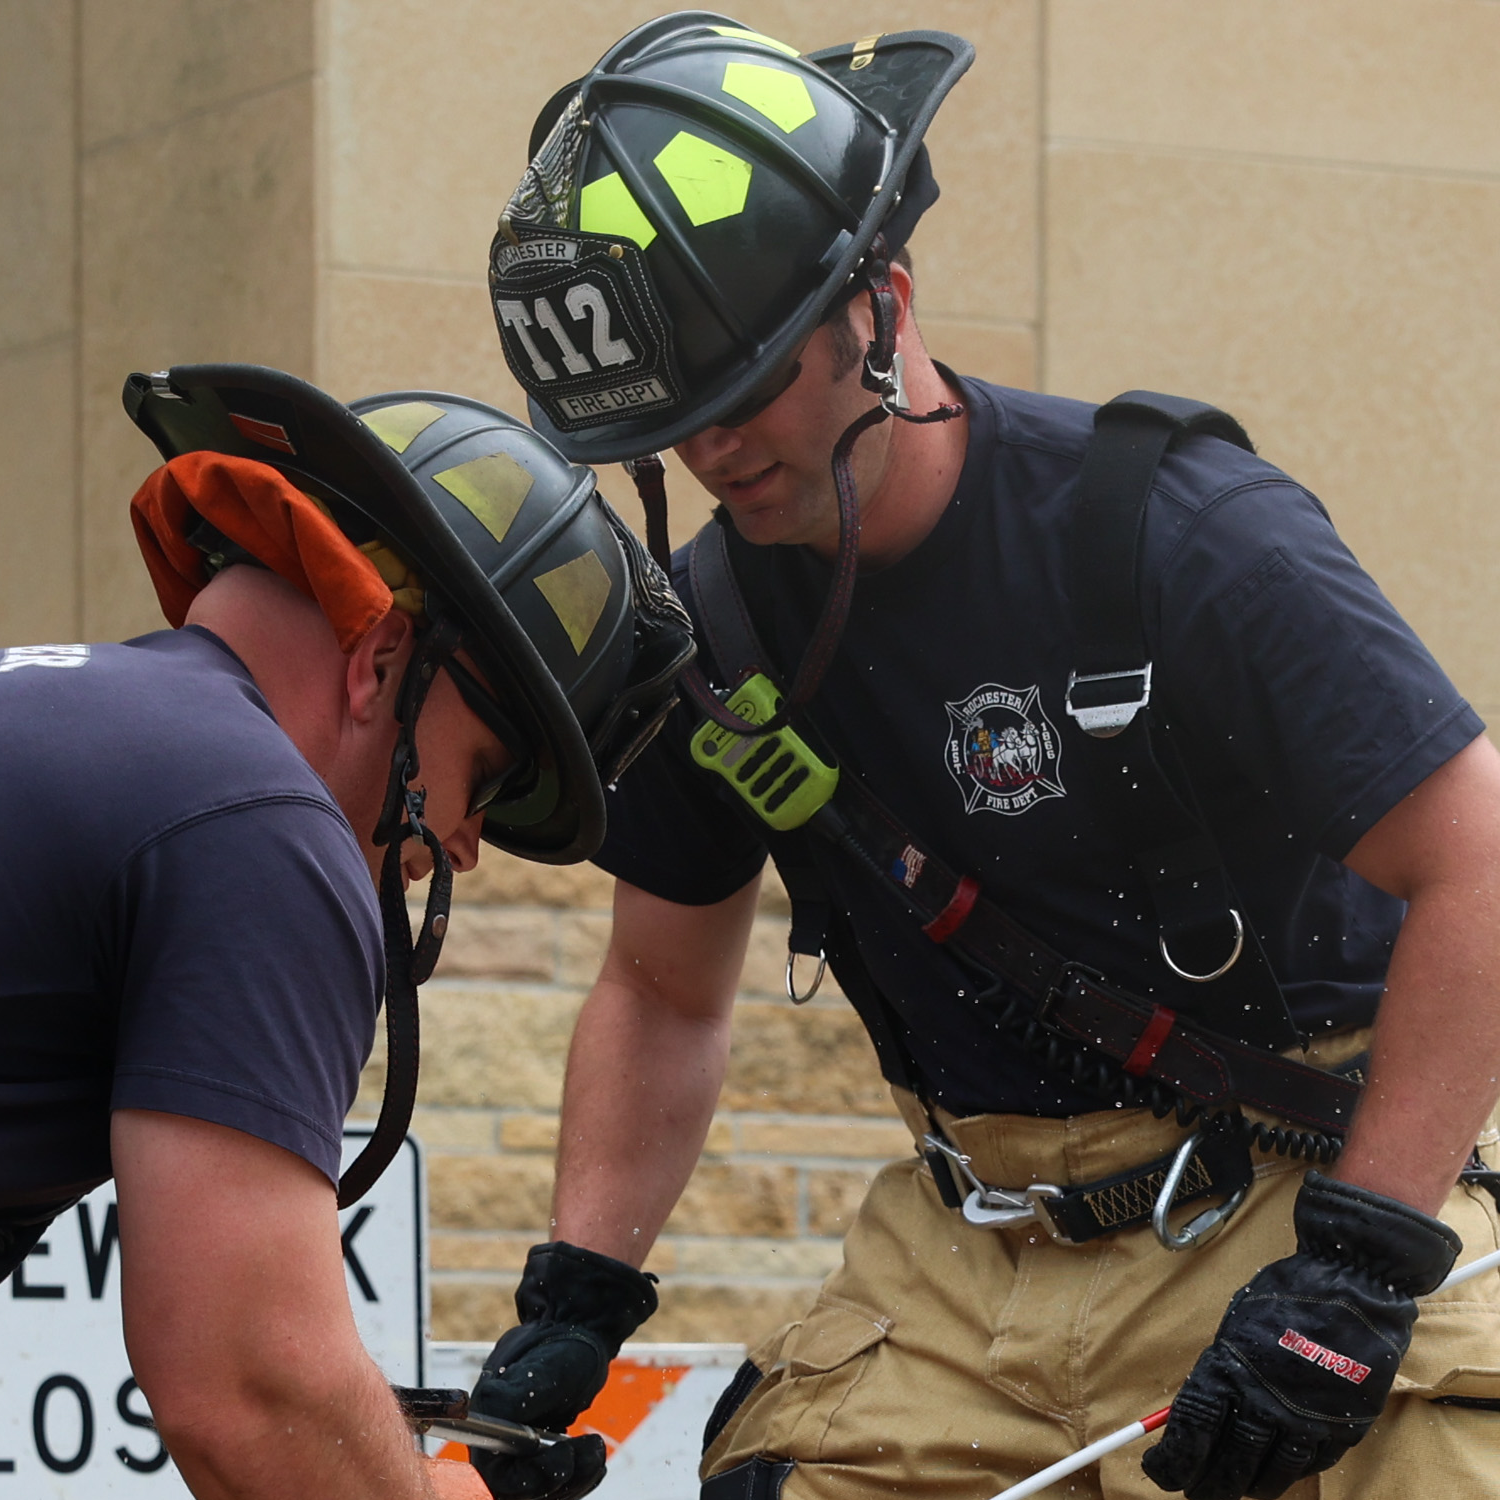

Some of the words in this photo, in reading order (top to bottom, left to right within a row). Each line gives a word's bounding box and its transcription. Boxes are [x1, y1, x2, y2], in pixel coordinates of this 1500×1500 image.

[497, 243, 566, 270] ROCHESTER
[497, 283, 636, 381] T12
[566, 394, 611, 416] FIRE
[609, 382, 659, 406] DEPT
[962, 692, 1023, 717] ROCHESTER
[950, 740, 966, 775] EST.
[1041, 722, 1055, 760] 1866
[986, 795, 1011, 810] FIRE
[1013, 787, 1038, 809] DEPT
[1278, 1328, 1372, 1385] EXCALIBUR
